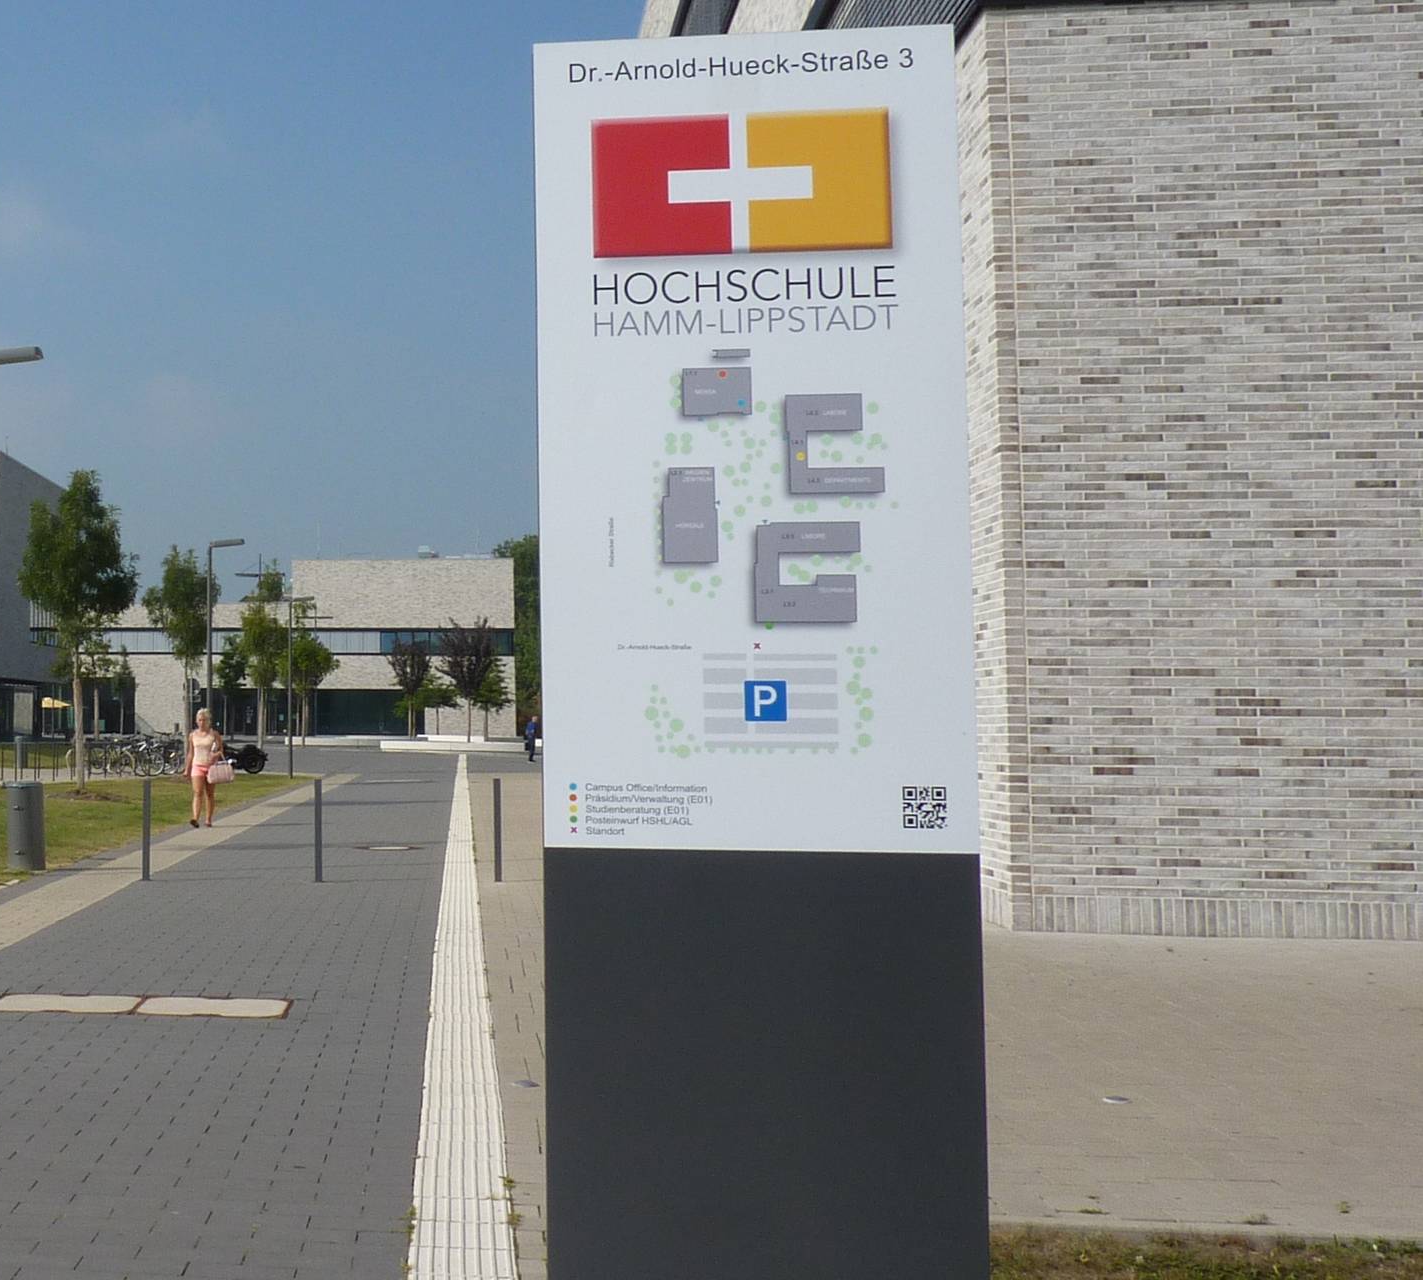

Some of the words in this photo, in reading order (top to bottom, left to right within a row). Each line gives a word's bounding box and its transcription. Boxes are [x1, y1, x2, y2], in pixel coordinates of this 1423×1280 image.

[568, 49, 889, 84] Dr.-Arnold-Hueck-Straße
[898, 47, 915, 69] 3
[592, 265, 898, 306] HOCHSCHULE
[592, 304, 900, 338] HAMM-LIPPSTADT
[753, 685, 778, 718] P
[585, 783, 623, 793] Campus
[626, 783, 708, 793] Office/Information
[585, 794, 685, 805] Präsidium/Verwaltung
[687, 795, 713, 805] (E01)
[585, 806, 661, 816] Studienberatung
[663, 806, 690, 816] (E01)
[585, 816, 639, 826] Posteinwurf
[642, 817, 693, 826] HSHL/AGL
[586, 827, 625, 836] Standort
